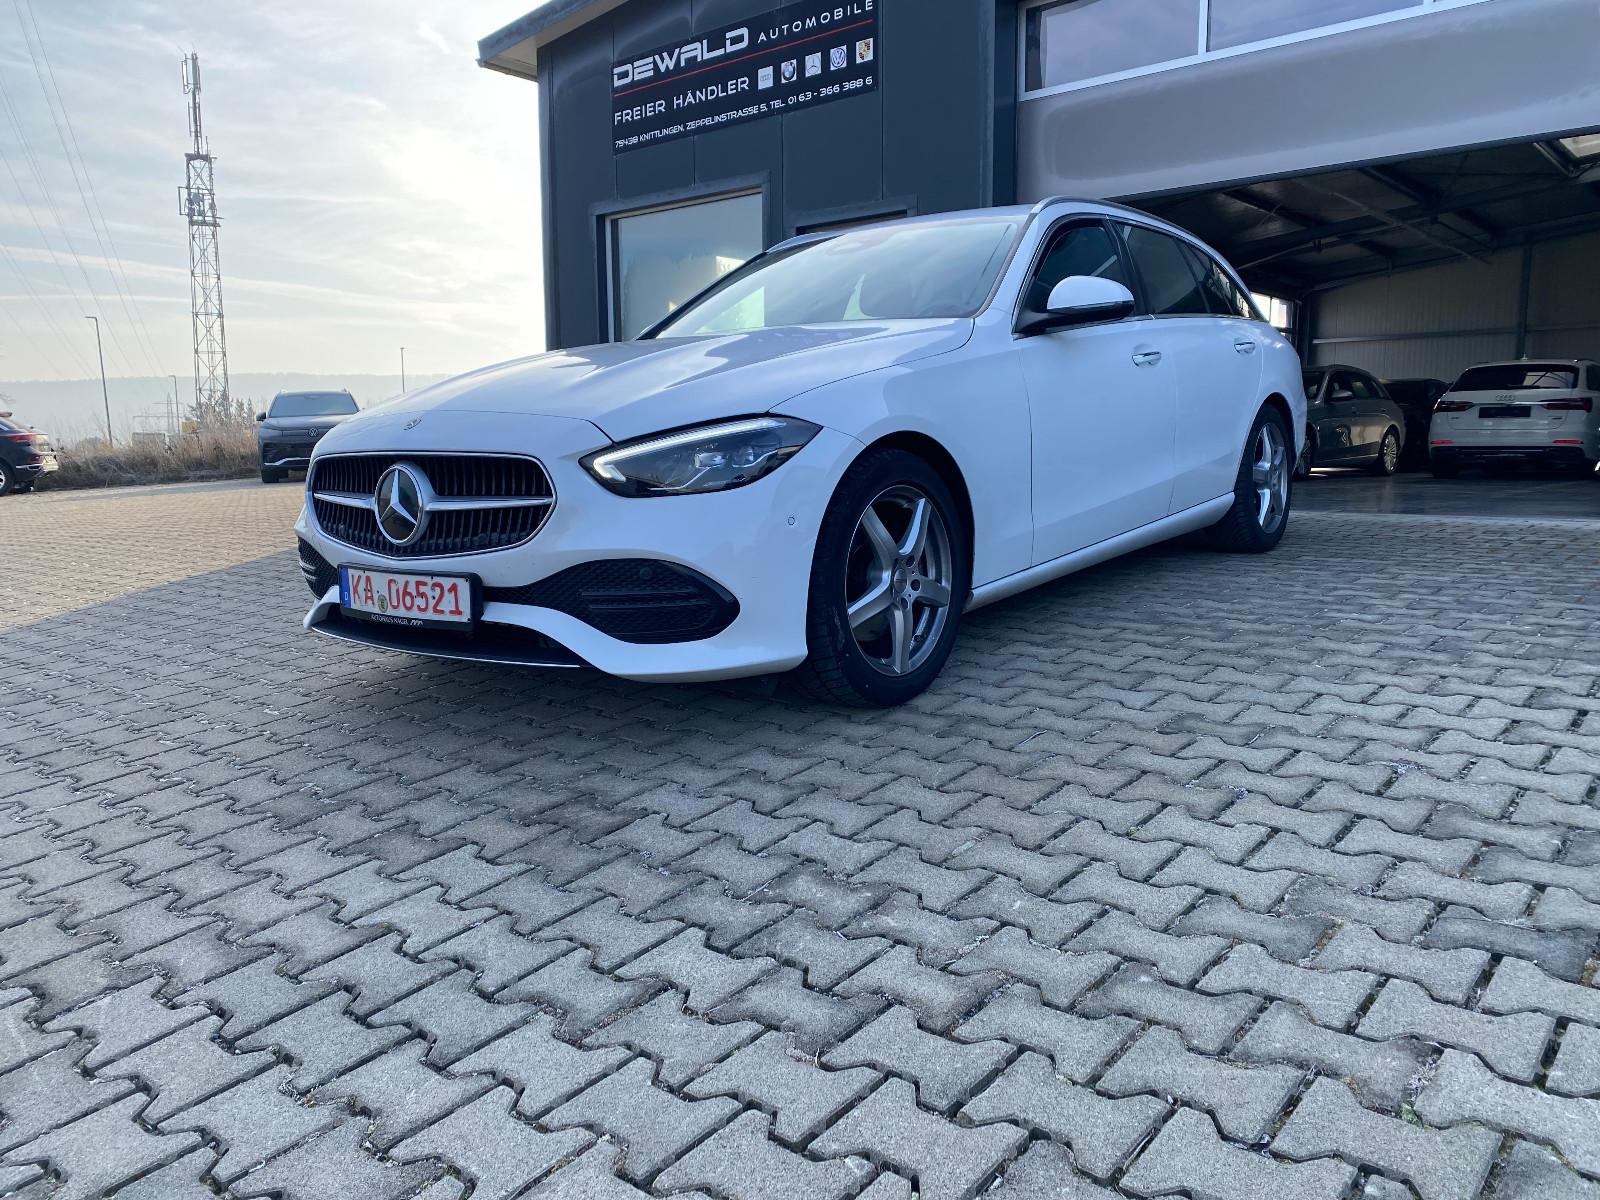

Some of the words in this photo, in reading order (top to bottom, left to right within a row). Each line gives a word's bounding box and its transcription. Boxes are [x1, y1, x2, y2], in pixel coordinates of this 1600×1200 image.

[613, 27, 749, 88] DEWALD
[757, 0, 874, 43] AUTOMOBILE
[614, 100, 666, 126] FREIER
[673, 77, 749, 109] HÄNDLER
[614, 135, 639, 148] 75438
[685, 105, 759, 130] ZEPPELINSTRASSE
[344, 591, 349, 601] D
[351, 574, 375, 607] KA
[387, 578, 463, 616] 06521
